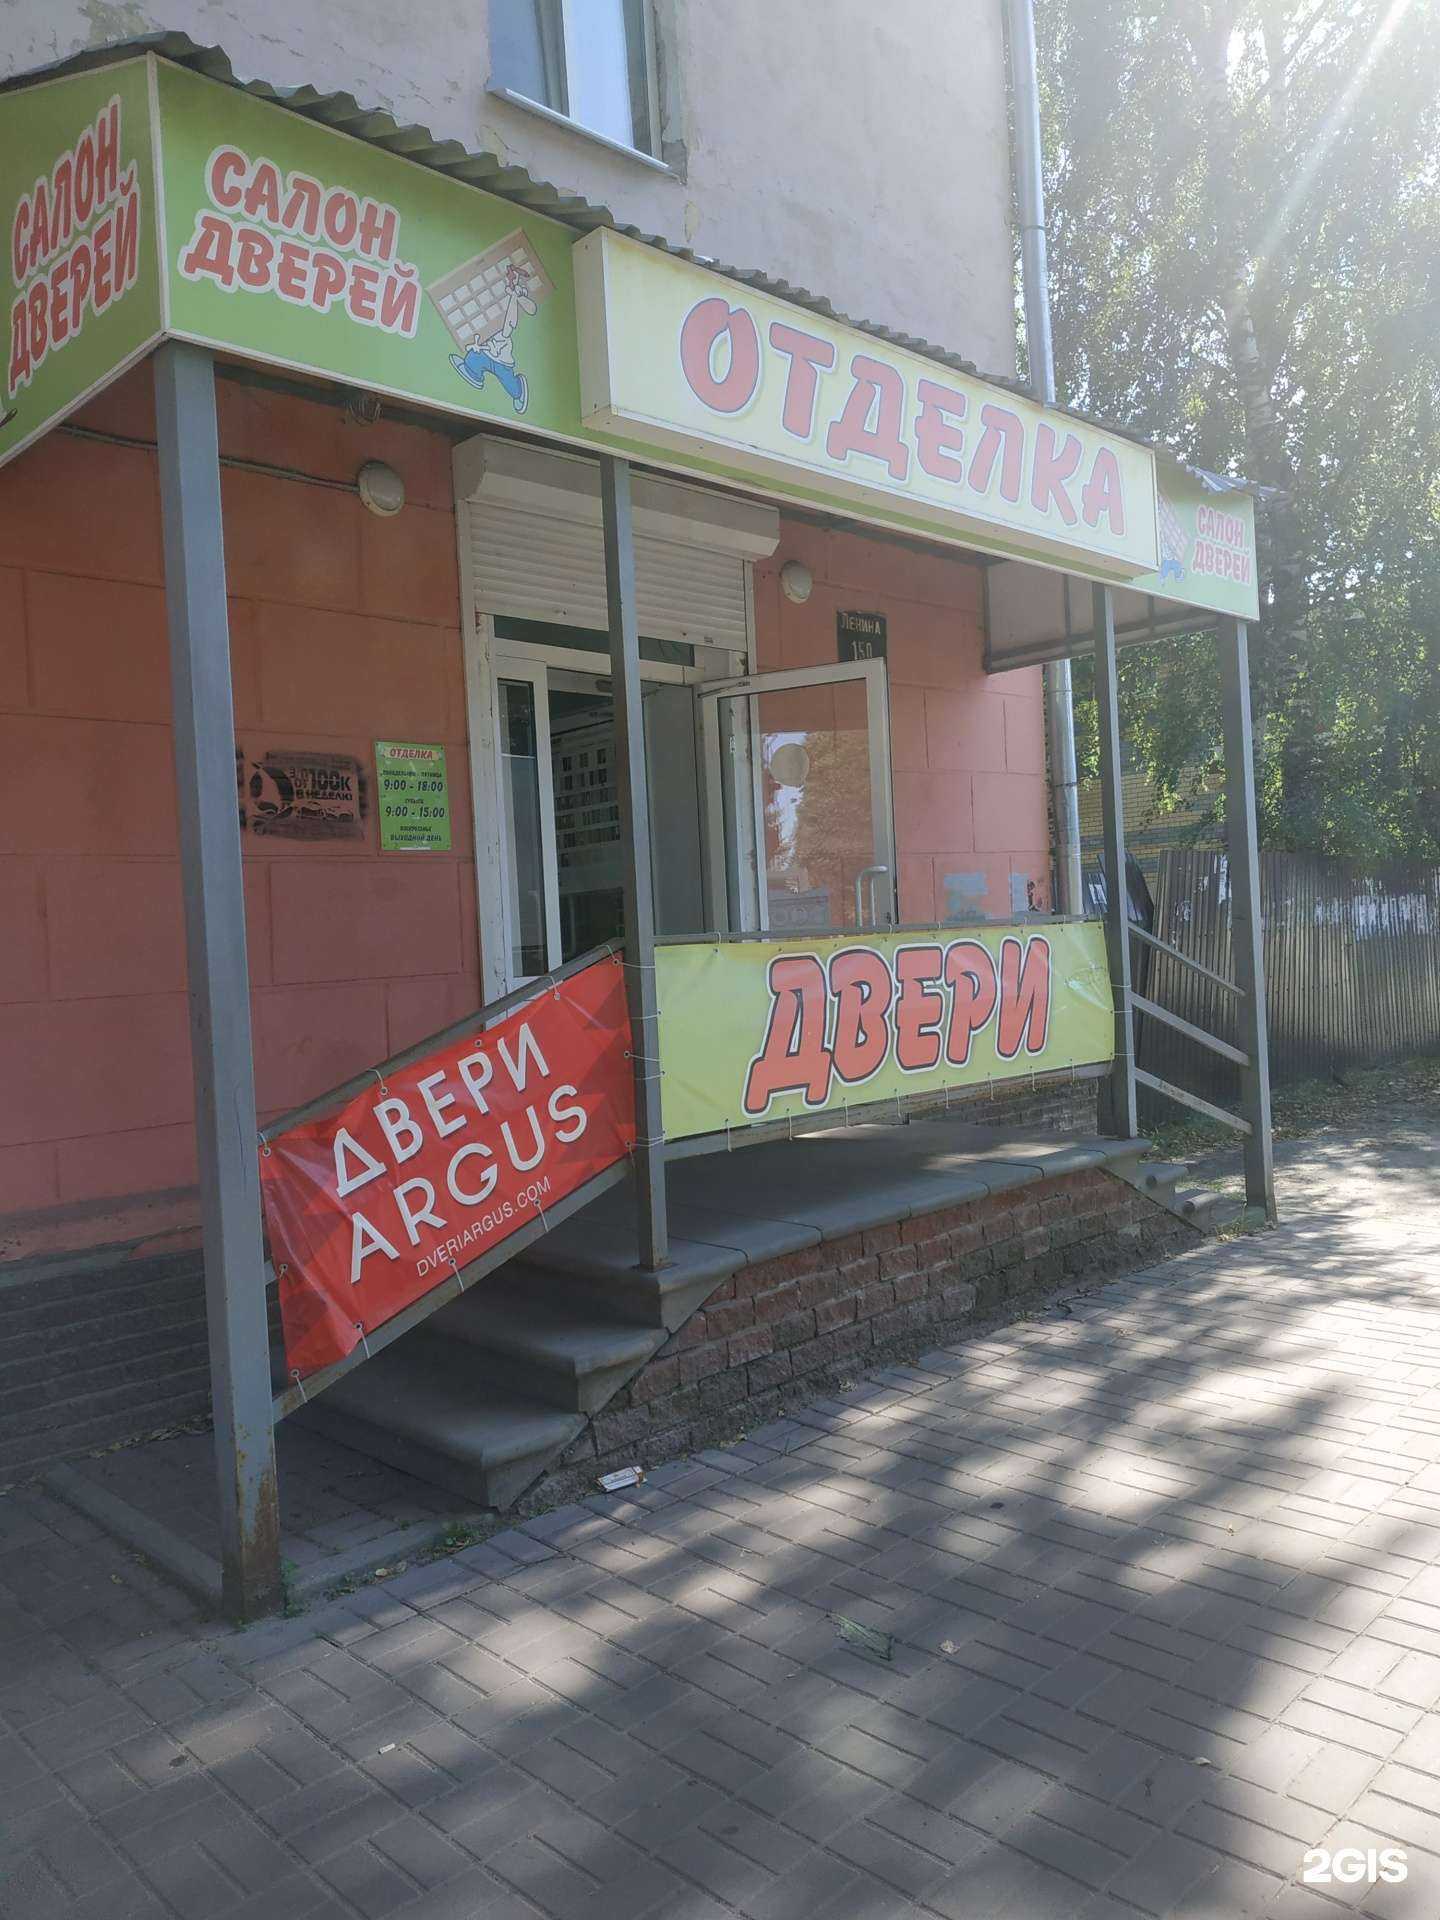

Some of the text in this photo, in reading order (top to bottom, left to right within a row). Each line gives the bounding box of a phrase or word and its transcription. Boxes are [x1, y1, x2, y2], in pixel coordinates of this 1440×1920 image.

[13, 100, 119, 283] САЛОН
[208, 148, 397, 261] САЛОН
[9, 163, 139, 395] ДВЕРЕЙ
[183, 213, 420, 335] ДВЕРЕЙ
[679, 297, 1125, 536] ОТДЕЛКА
[1193, 539, 1250, 586] ДВЕРЕЙ
[1196, 505, 1244, 549] САЛОН
[839, 613, 881, 635] ЛЕНИНА
[852, 640, 873, 660] 150
[384, 779, 407, 791] 9:00
[417, 780, 443, 792] 18:00
[389, 748, 433, 760] ОТДЕЛКА
[385, 806, 408, 817] 9:00
[419, 807, 445, 818] 15:00
[741, 934, 1052, 1118] ДВЕРИ
[334, 1022, 551, 1198] ДВЕРИ
[350, 1084, 588, 1284] ARGUS
[415, 1175, 552, 1278] DVERIARGUS.COM
